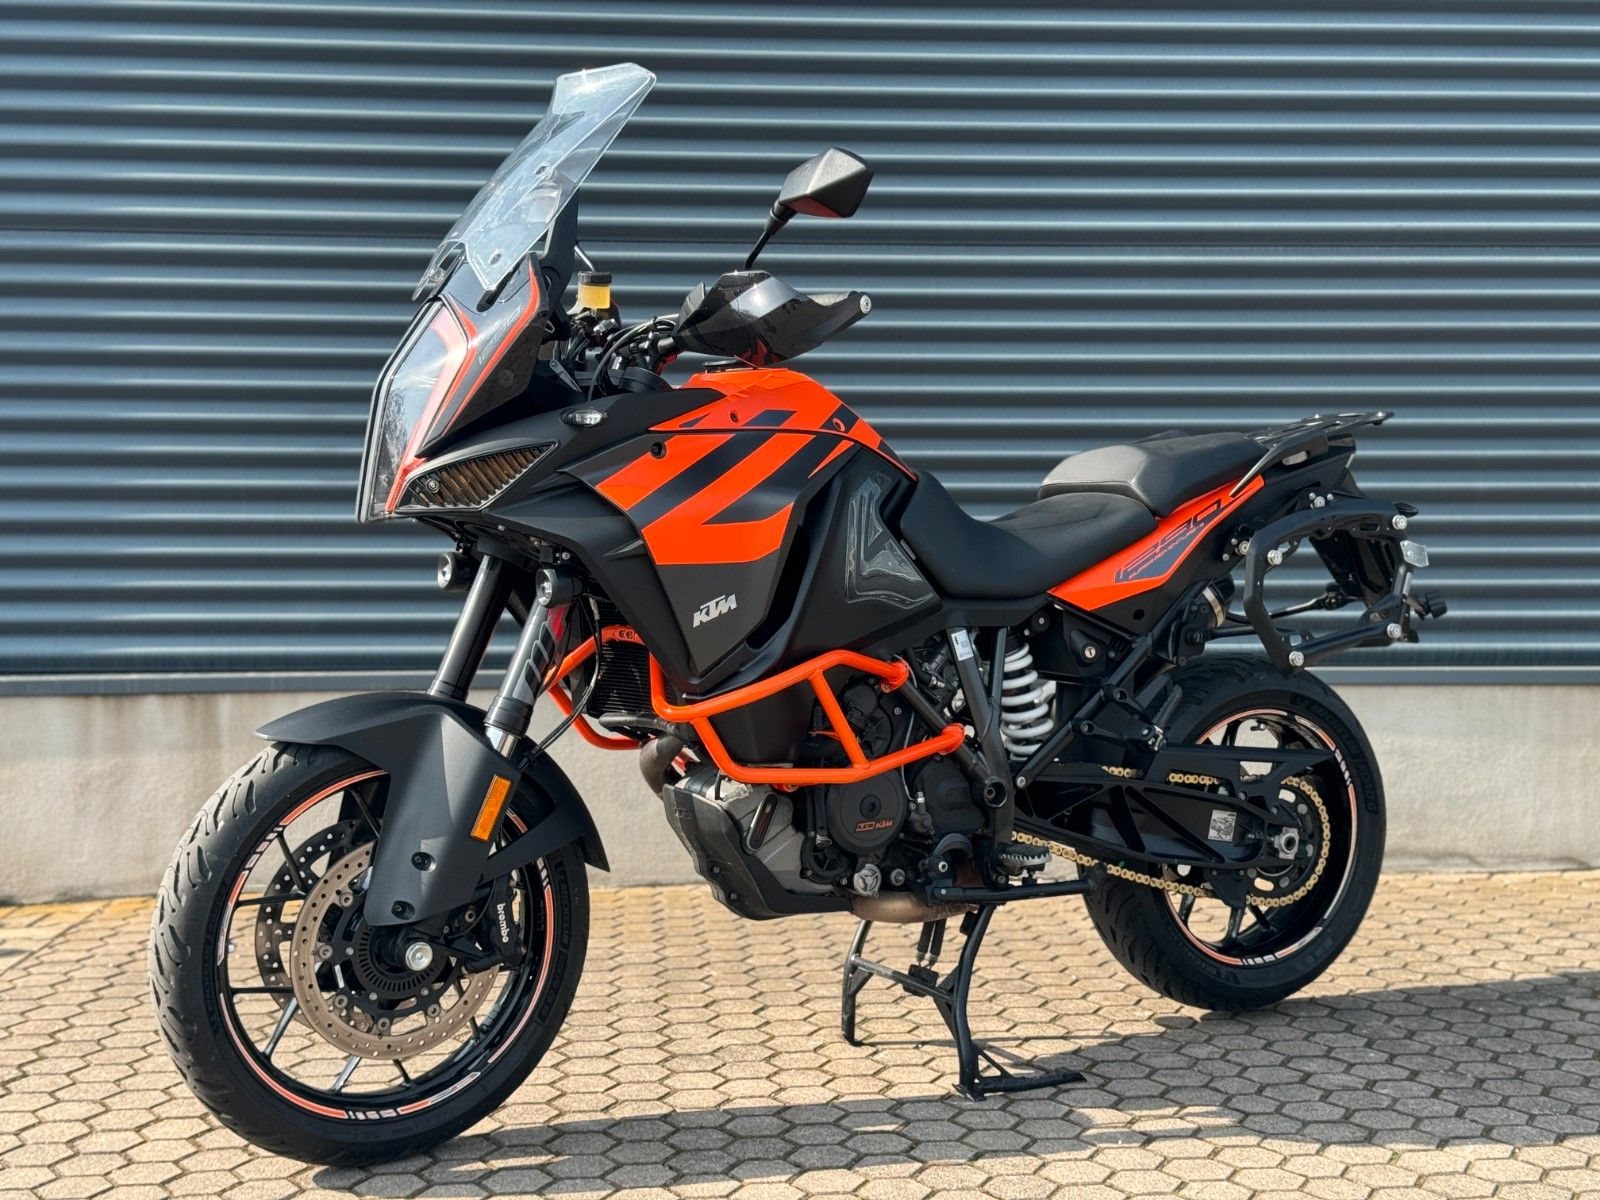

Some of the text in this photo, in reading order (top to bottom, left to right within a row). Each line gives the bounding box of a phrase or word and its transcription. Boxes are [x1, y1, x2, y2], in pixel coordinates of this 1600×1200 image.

[693, 593, 738, 629] KTM
[496, 902, 510, 943] brembo
[559, 881, 571, 944] MICHELIN
